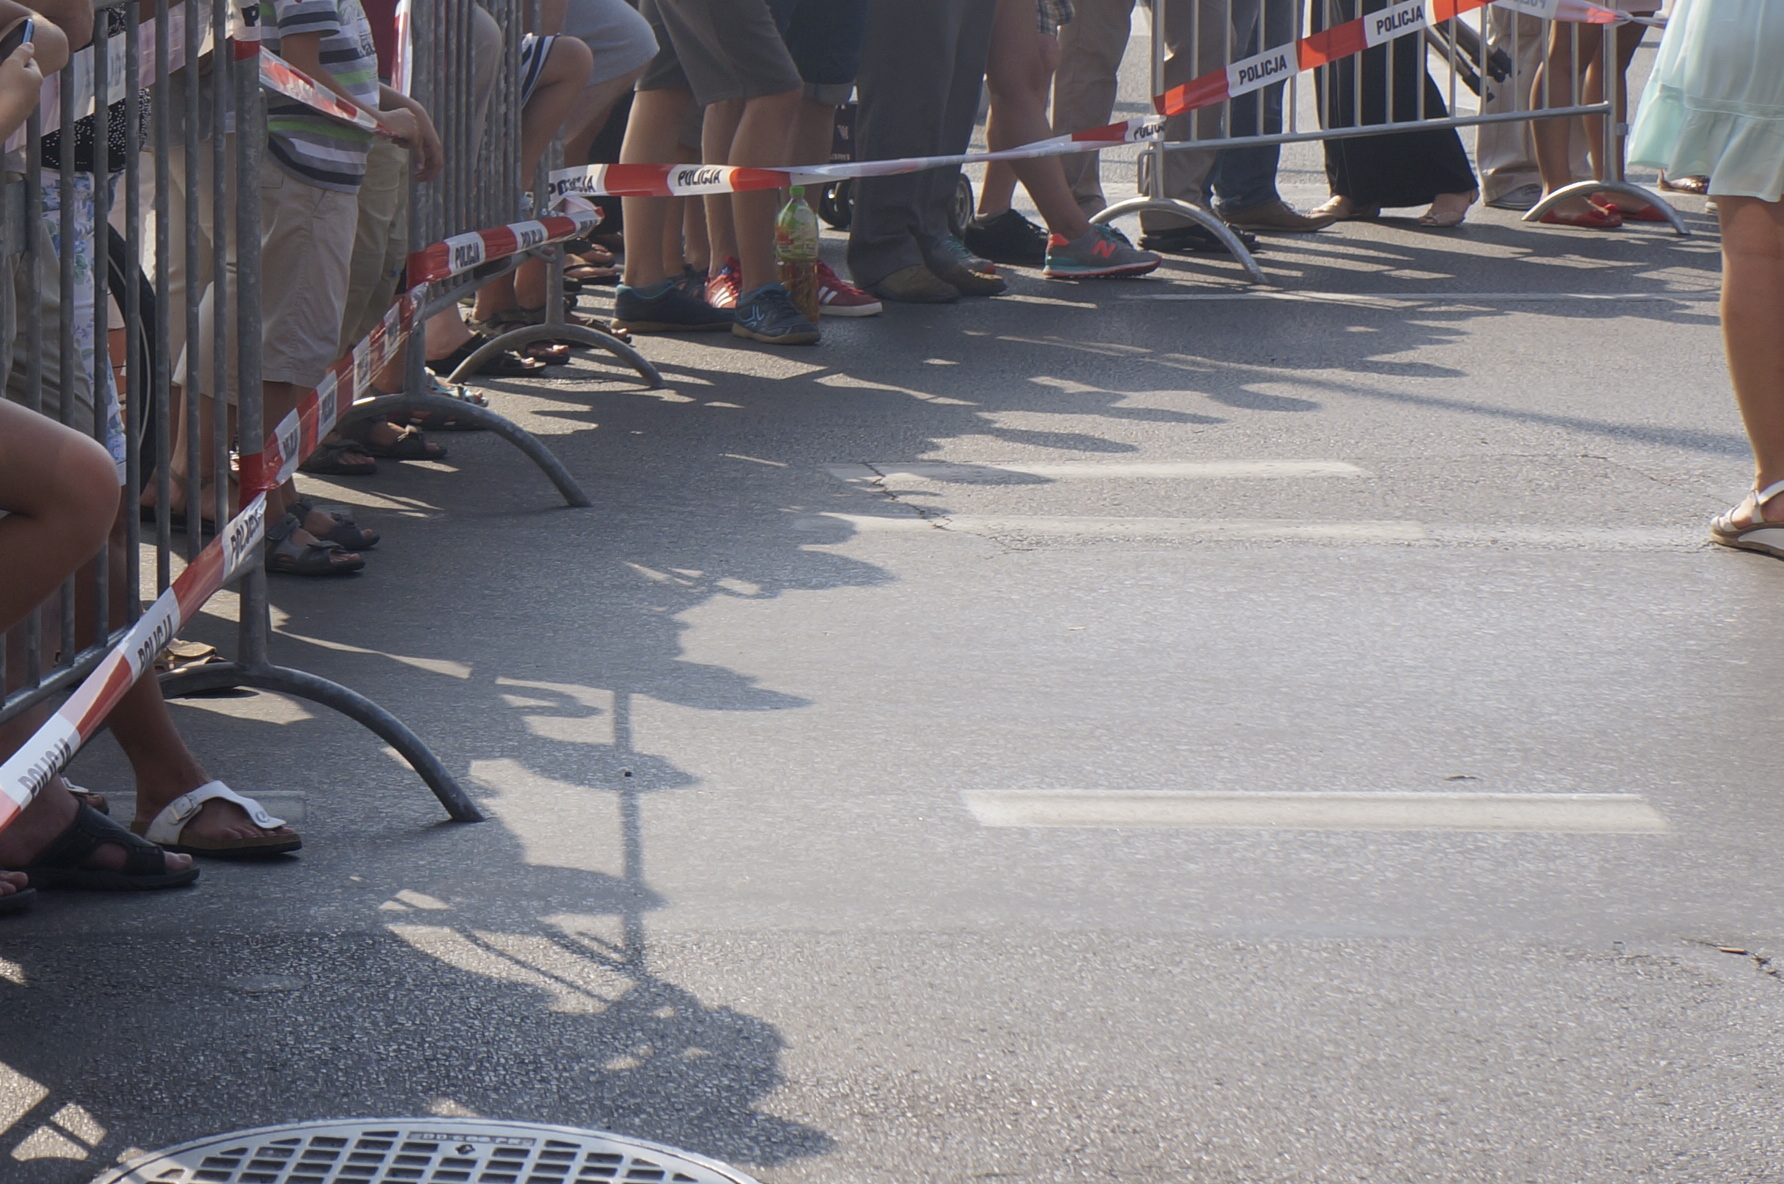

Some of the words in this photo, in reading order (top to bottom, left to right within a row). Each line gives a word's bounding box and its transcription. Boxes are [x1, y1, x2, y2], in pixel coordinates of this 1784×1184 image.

[1376, 5, 1424, 36] POLICJA
[1238, 54, 1288, 86] POLICJA
[677, 168, 723, 188] POLICJA
[455, 240, 481, 269] POLICJA
